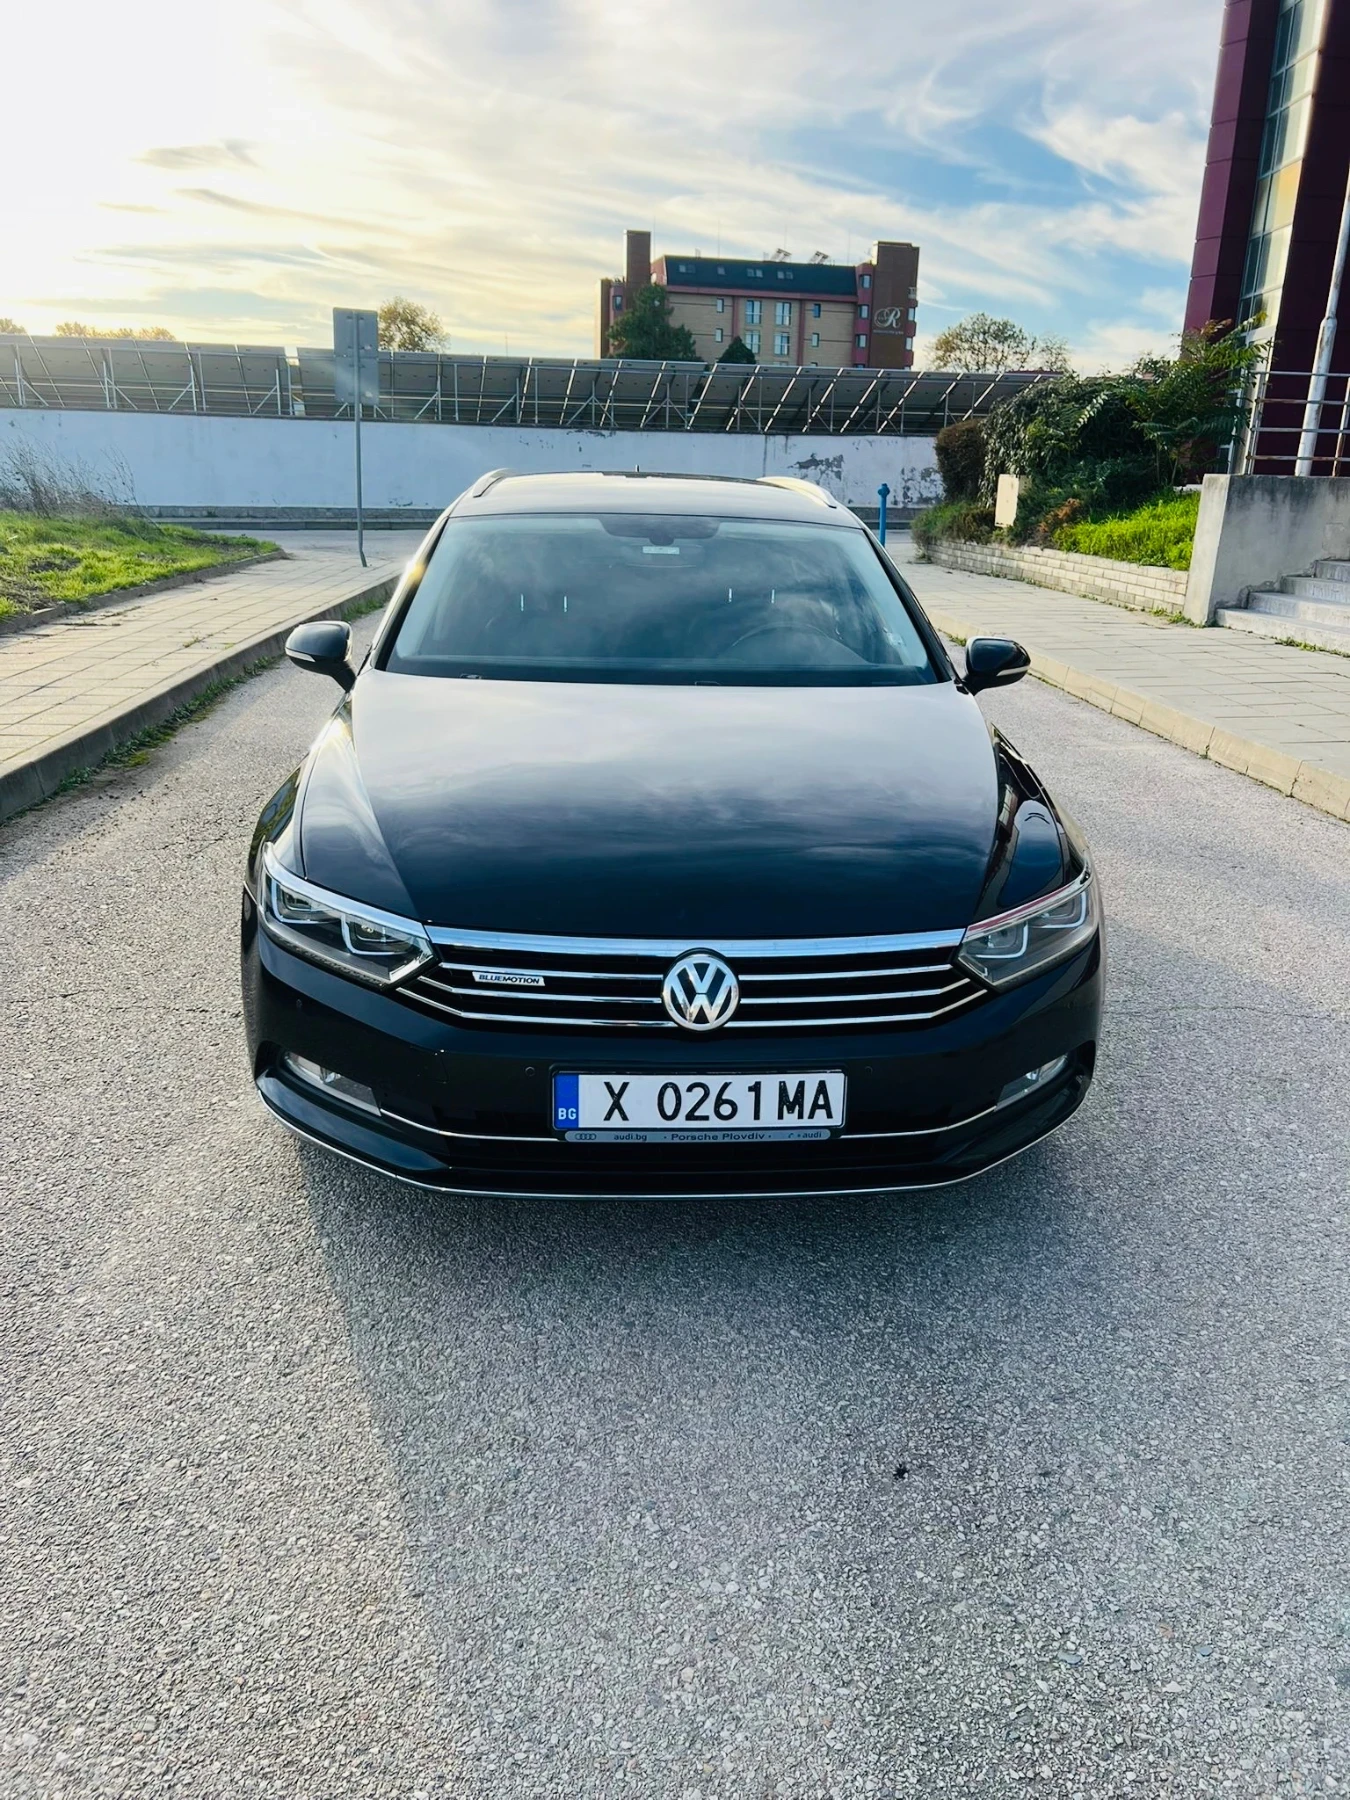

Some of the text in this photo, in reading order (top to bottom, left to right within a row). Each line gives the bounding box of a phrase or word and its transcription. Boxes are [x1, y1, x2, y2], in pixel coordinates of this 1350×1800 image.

[478, 974, 540, 985] BLUEMOTION
[667, 957, 735, 1027] VW
[603, 1081, 630, 1121] X
[558, 1107, 577, 1120] BG
[613, 1132, 648, 1142] audi.bg
[671, 1132, 719, 1141] Porsche
[722, 1132, 765, 1141] Plovdiv
